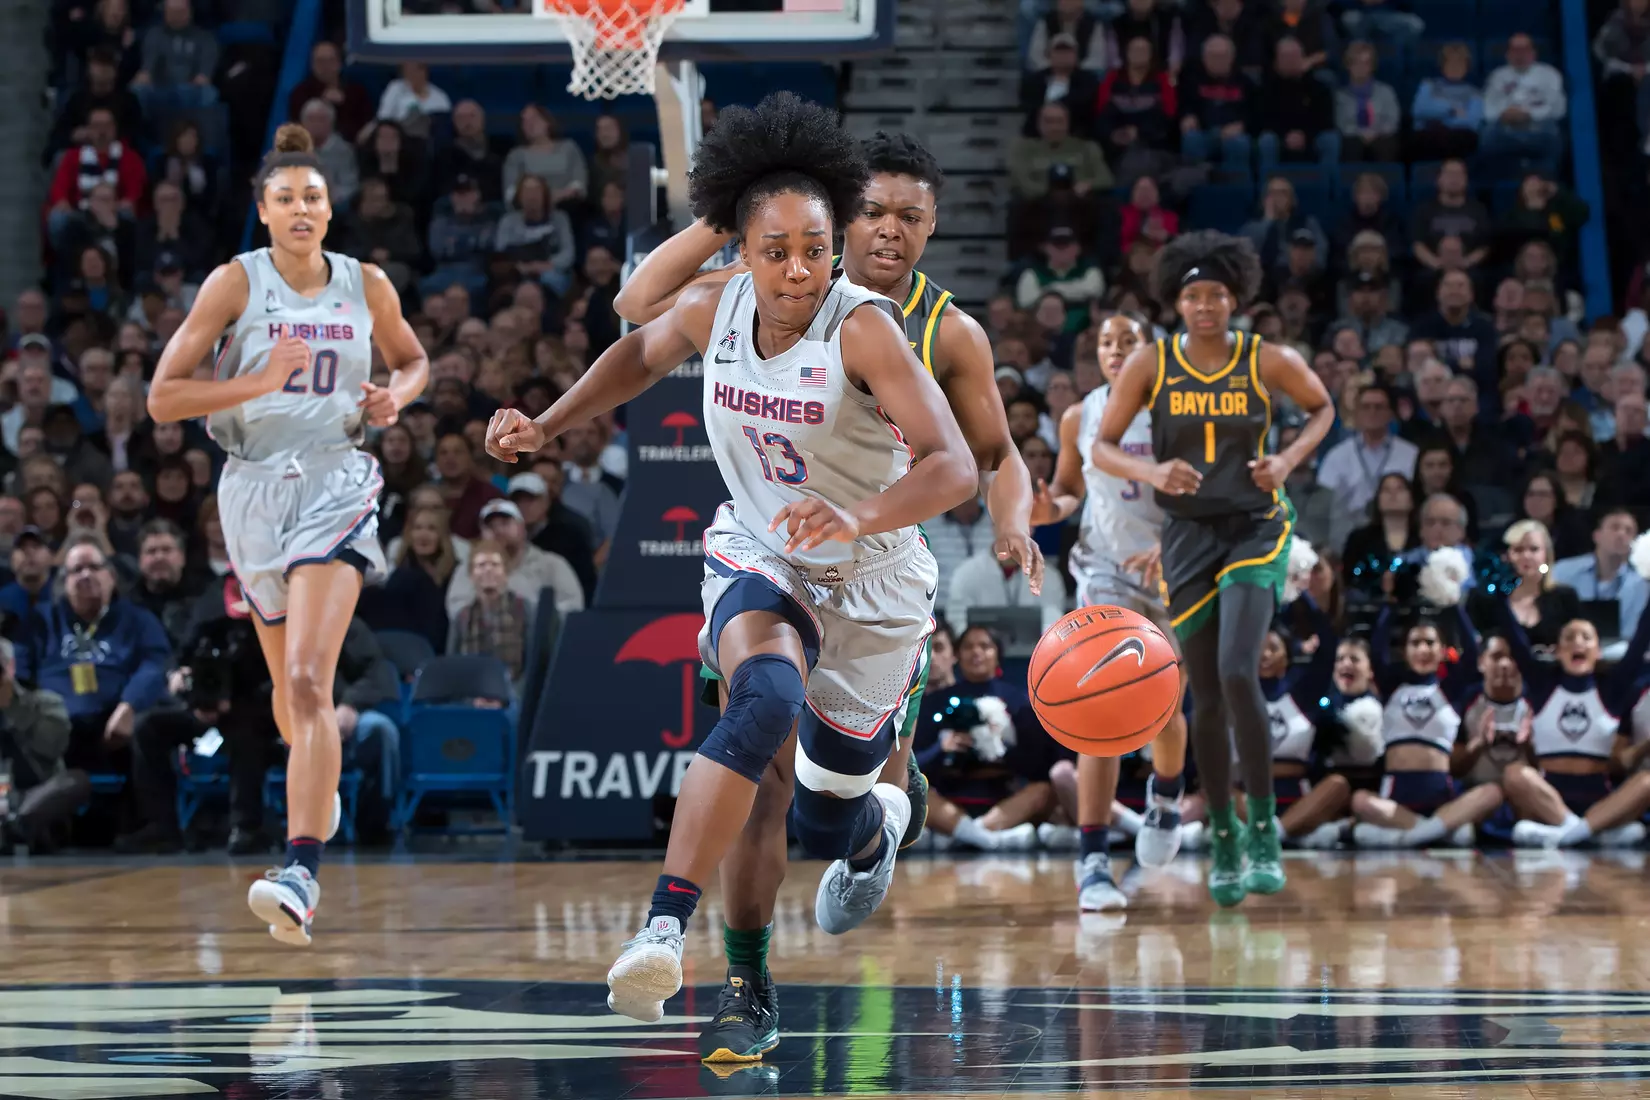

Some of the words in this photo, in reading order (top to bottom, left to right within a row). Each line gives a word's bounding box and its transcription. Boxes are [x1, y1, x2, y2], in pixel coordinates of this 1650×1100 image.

[268, 323, 354, 341] HUSKIES
[281, 348, 339, 396] 20
[713, 381, 825, 425] HUSKIES
[1168, 391, 1248, 416] BAYLOR
[742, 425, 809, 486] 13
[1204, 420, 1216, 464] 1
[638, 540, 703, 556] TRAVELE
[1055, 607, 1124, 641] ELITE
[526, 751, 698, 799] TRAVE
